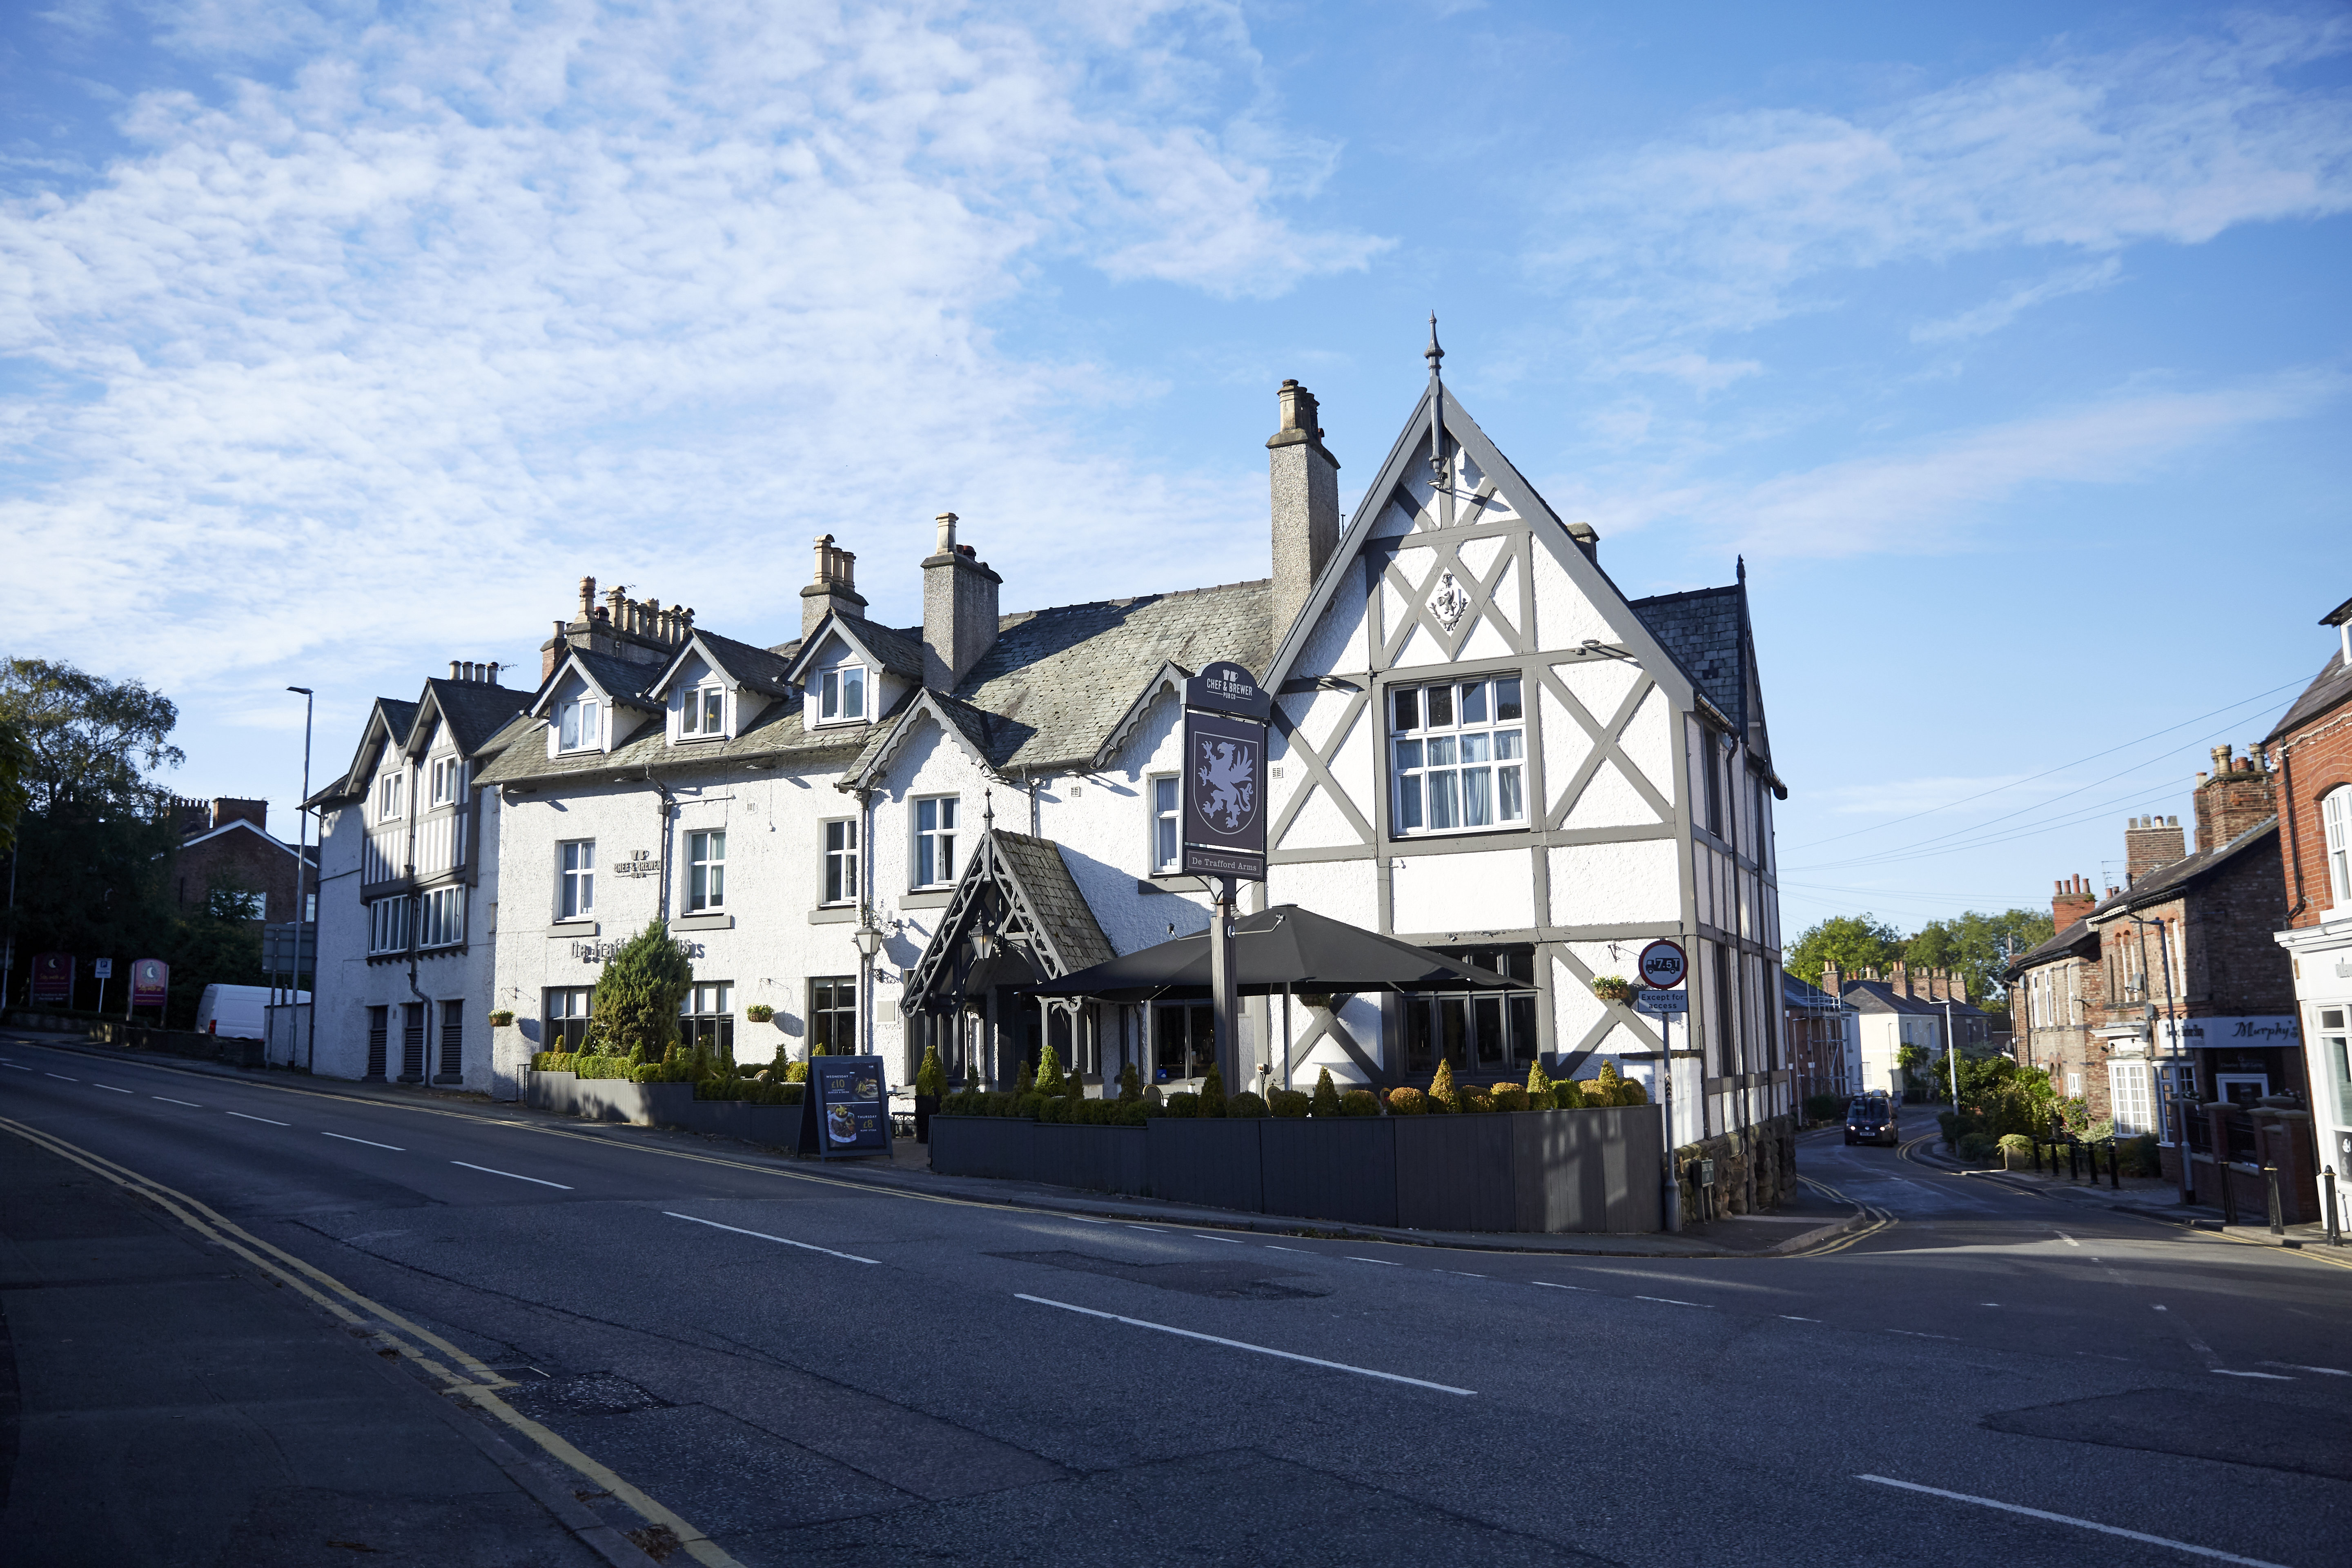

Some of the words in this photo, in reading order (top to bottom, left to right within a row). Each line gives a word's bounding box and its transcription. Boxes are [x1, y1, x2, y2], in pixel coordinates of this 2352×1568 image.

[1207, 678, 1222, 690] CHEF
[1223, 683, 1228, 691] &
[1229, 682, 1253, 696] BREWER
[614, 862, 629, 873] CHEF
[1192, 857, 1202, 866] De
[1205, 858, 1236, 869] Trafford
[1238, 862, 1257, 871] Arms
[572, 940, 586, 958] De
[1656, 958, 1679, 969] 7.5T
[2232, 1020, 2299, 1040] Murphy's
[831, 1079, 845, 1088] £10
[863, 1119, 873, 1128] £8
